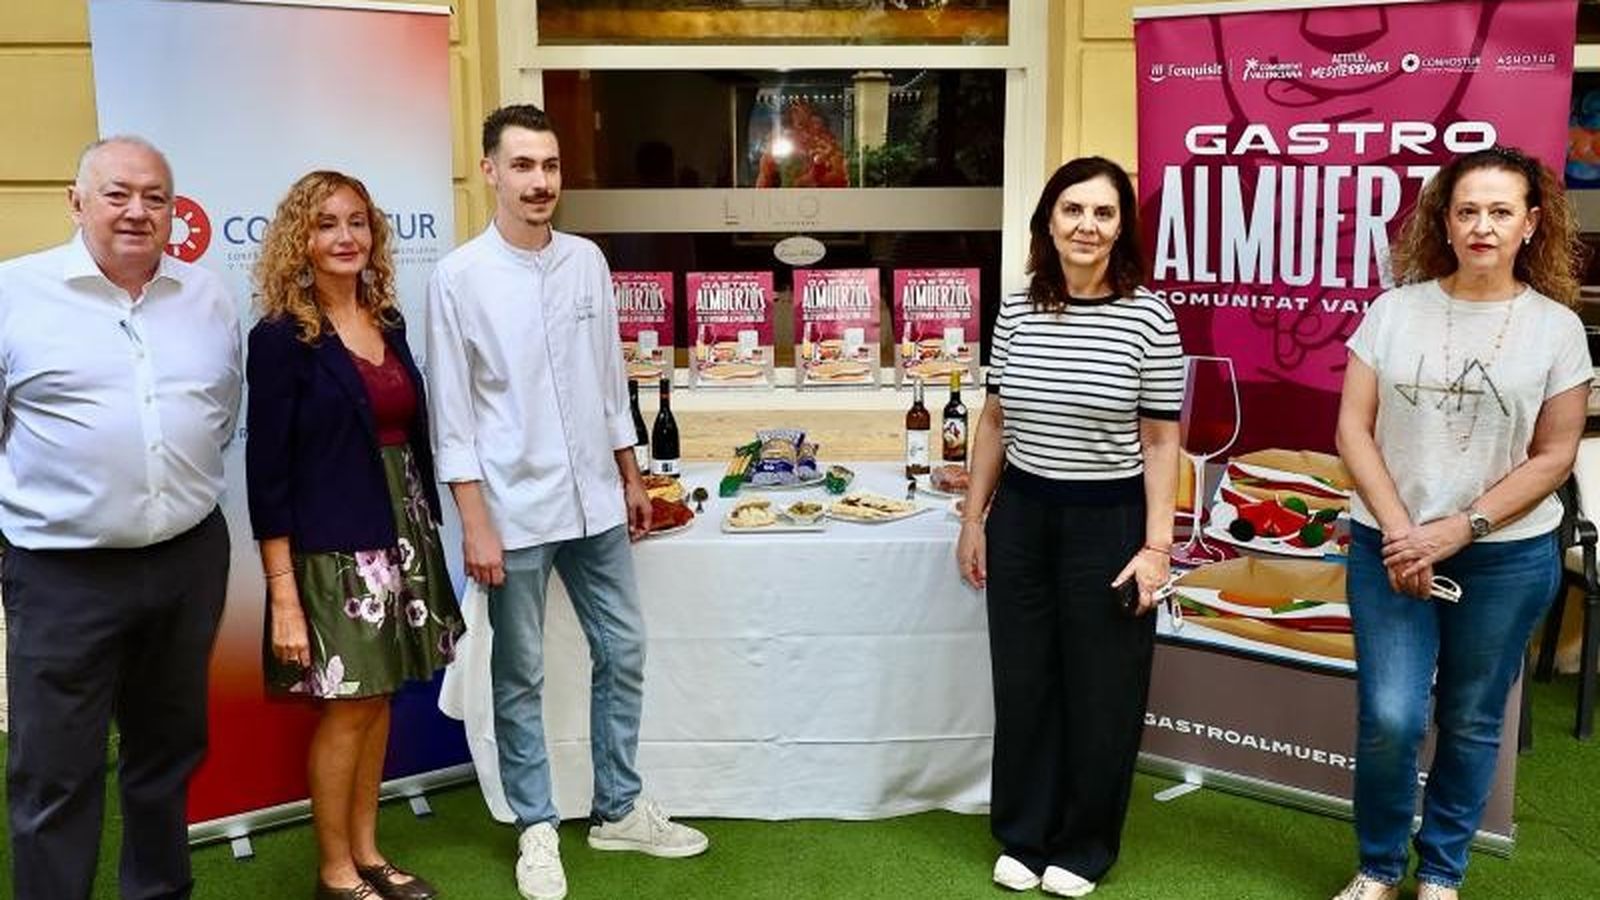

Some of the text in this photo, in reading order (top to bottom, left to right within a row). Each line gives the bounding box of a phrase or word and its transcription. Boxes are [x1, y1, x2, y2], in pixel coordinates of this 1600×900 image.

[1184, 121, 1498, 155] GASTRO
[1153, 165, 1441, 290] ALMUER
[696, 287, 766, 312] ALMUERZOS
[803, 284, 872, 309] ALMUERZOS
[903, 284, 972, 309] ALMUERZOS
[1155, 290, 1309, 311] COMUNITAT
